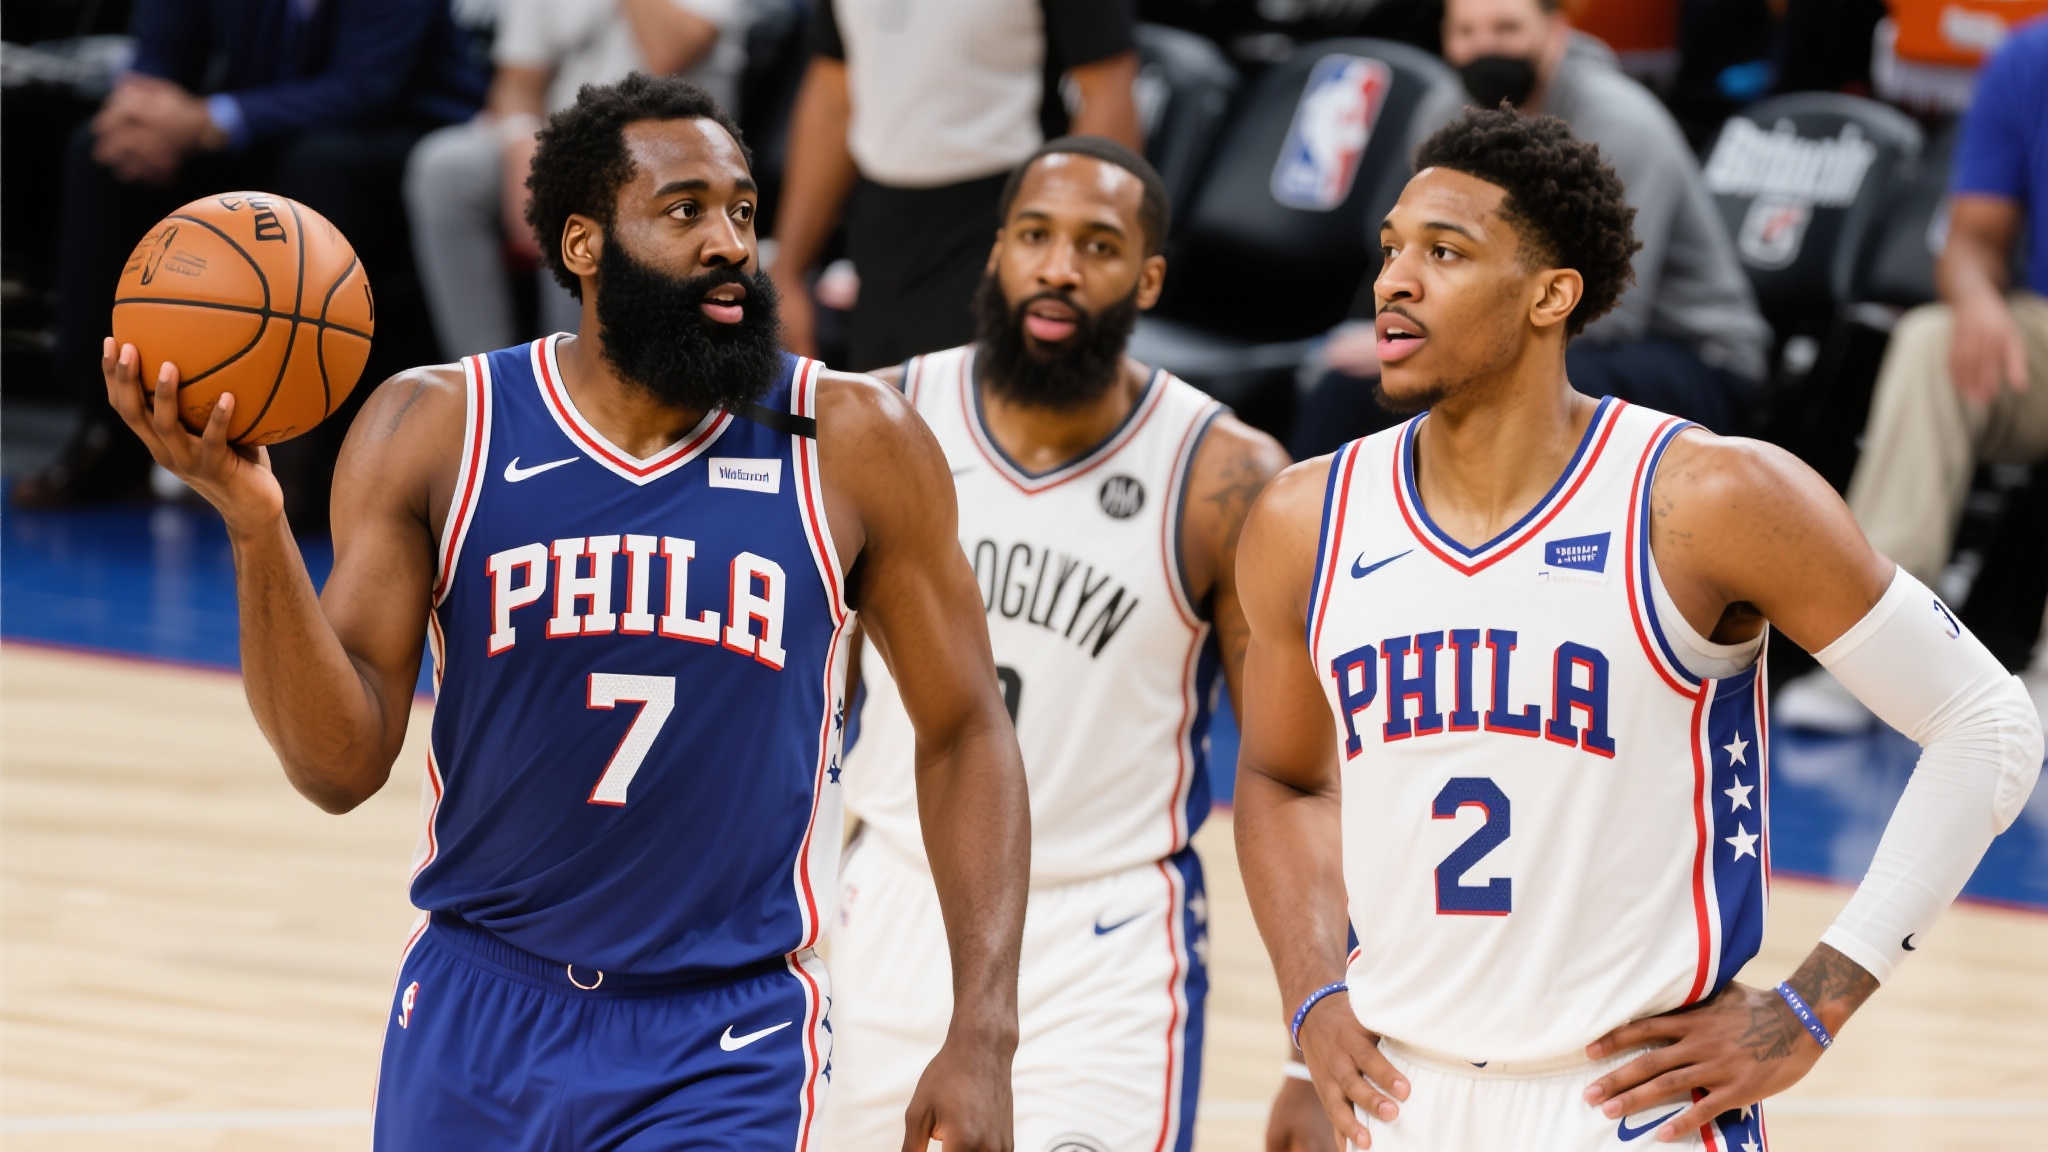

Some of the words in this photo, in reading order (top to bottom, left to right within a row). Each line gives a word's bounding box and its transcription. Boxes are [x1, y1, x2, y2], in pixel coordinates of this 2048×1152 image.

[486, 534, 787, 671] PHILA
[586, 672, 676, 807] 7
[1331, 628, 1615, 761] PHILA
[1432, 777, 1512, 916] 2
